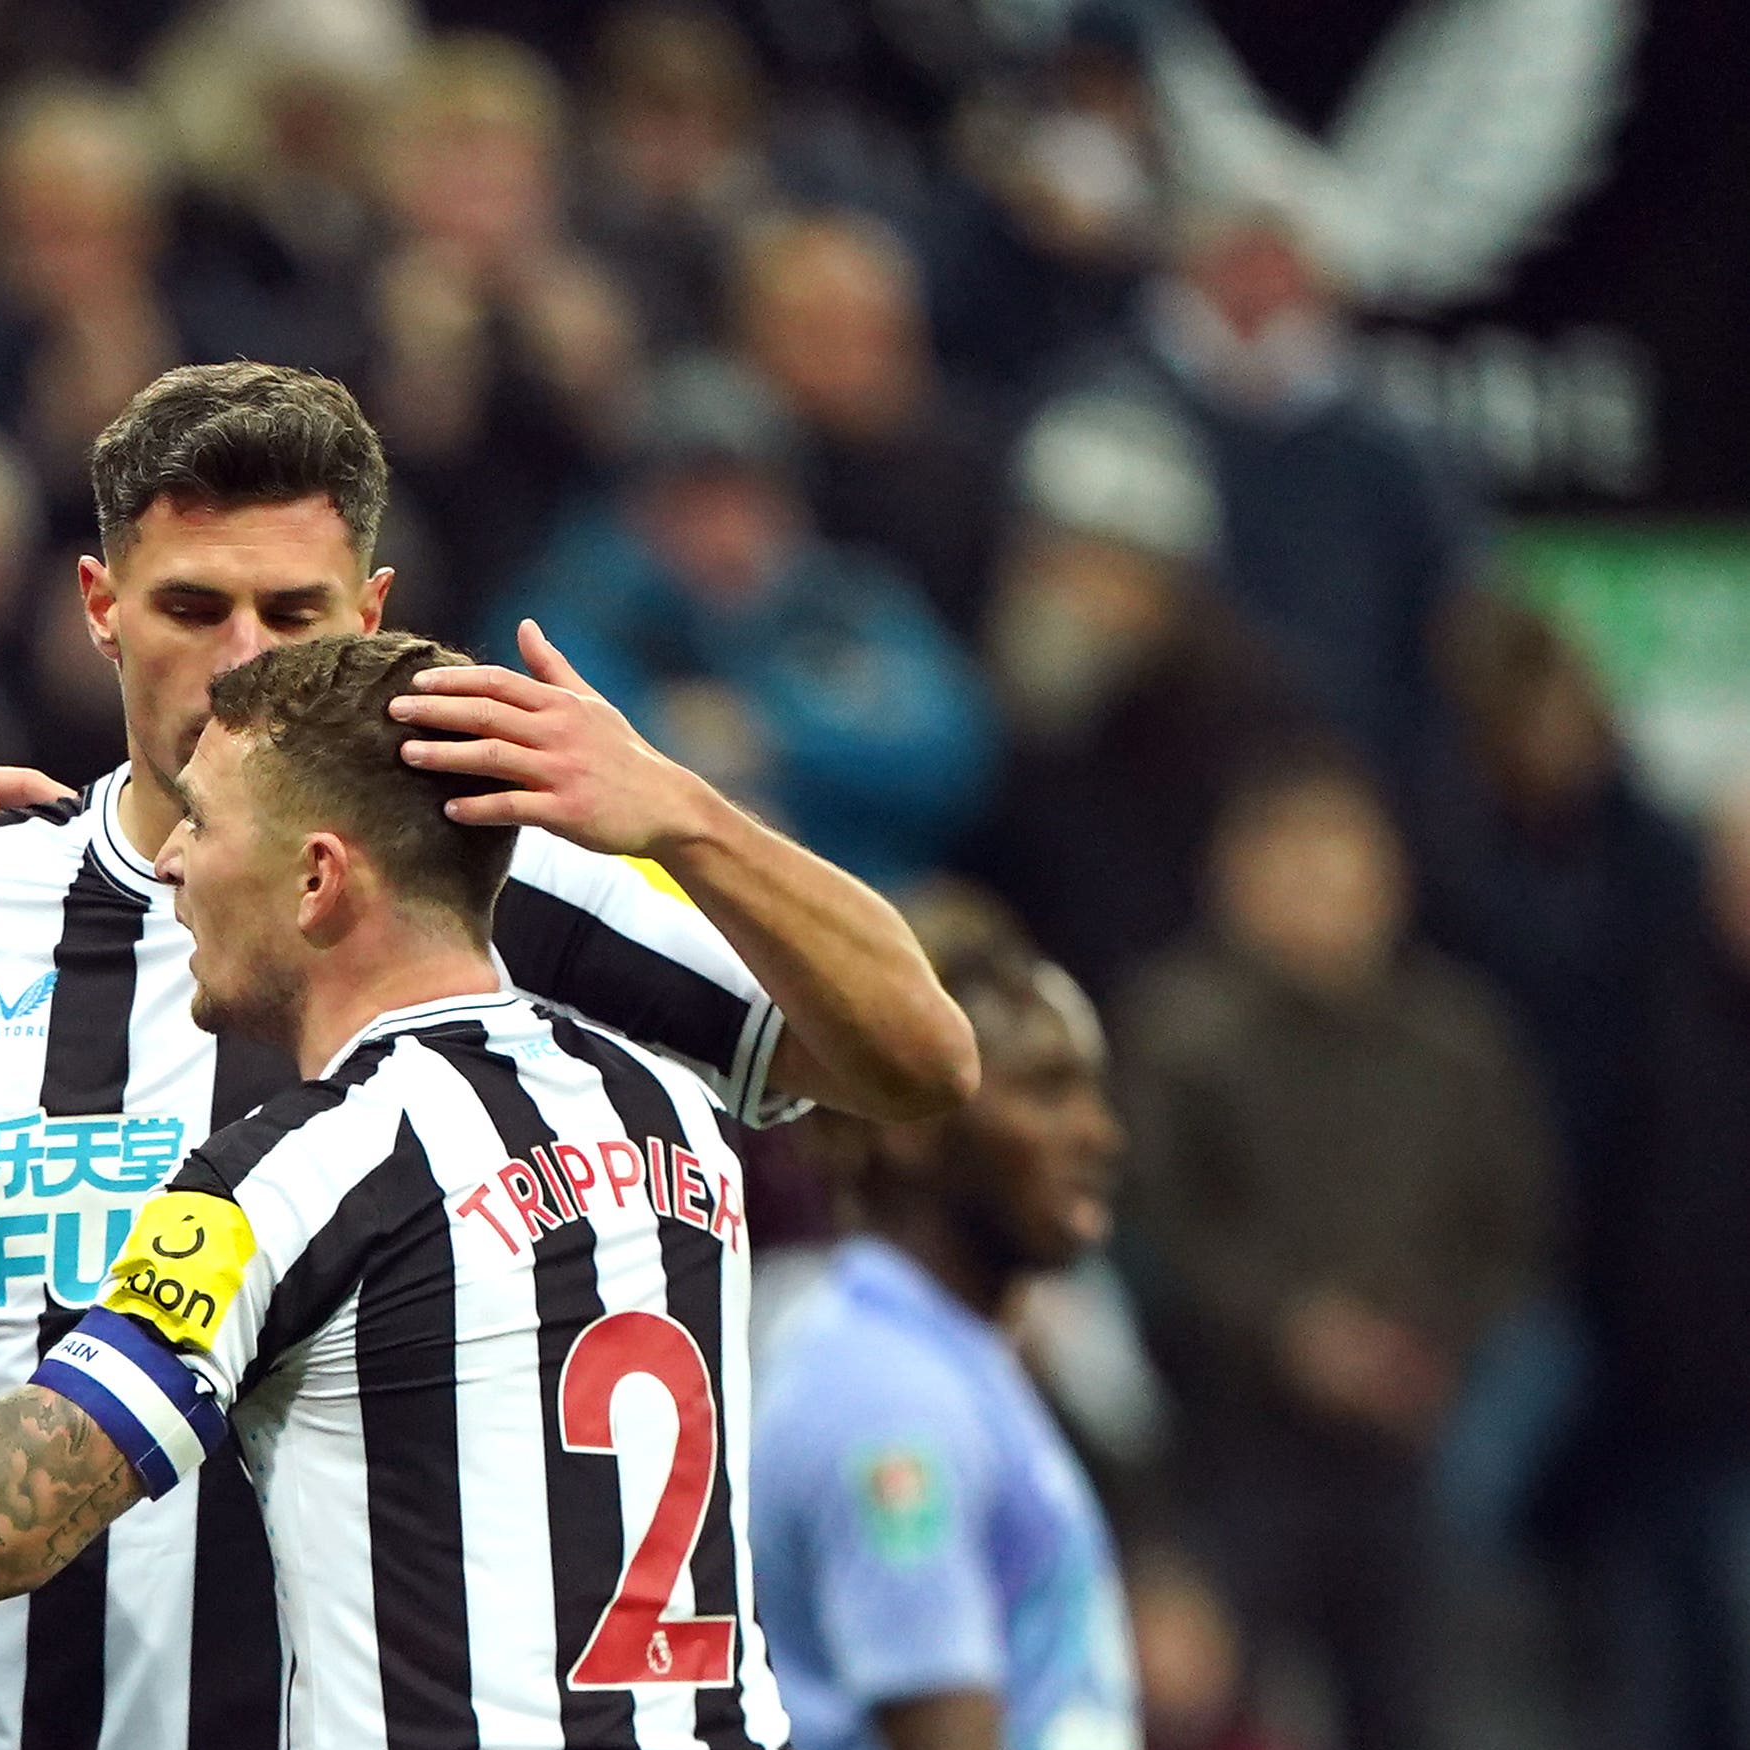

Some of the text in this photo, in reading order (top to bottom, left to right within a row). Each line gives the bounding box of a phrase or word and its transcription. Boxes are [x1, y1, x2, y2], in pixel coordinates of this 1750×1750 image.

[456, 1137, 743, 1256] TRIPPIER
[120, 1268, 216, 1329] oon
[59, 1340, 99, 1363] AIN
[558, 1311, 736, 1691] 2
